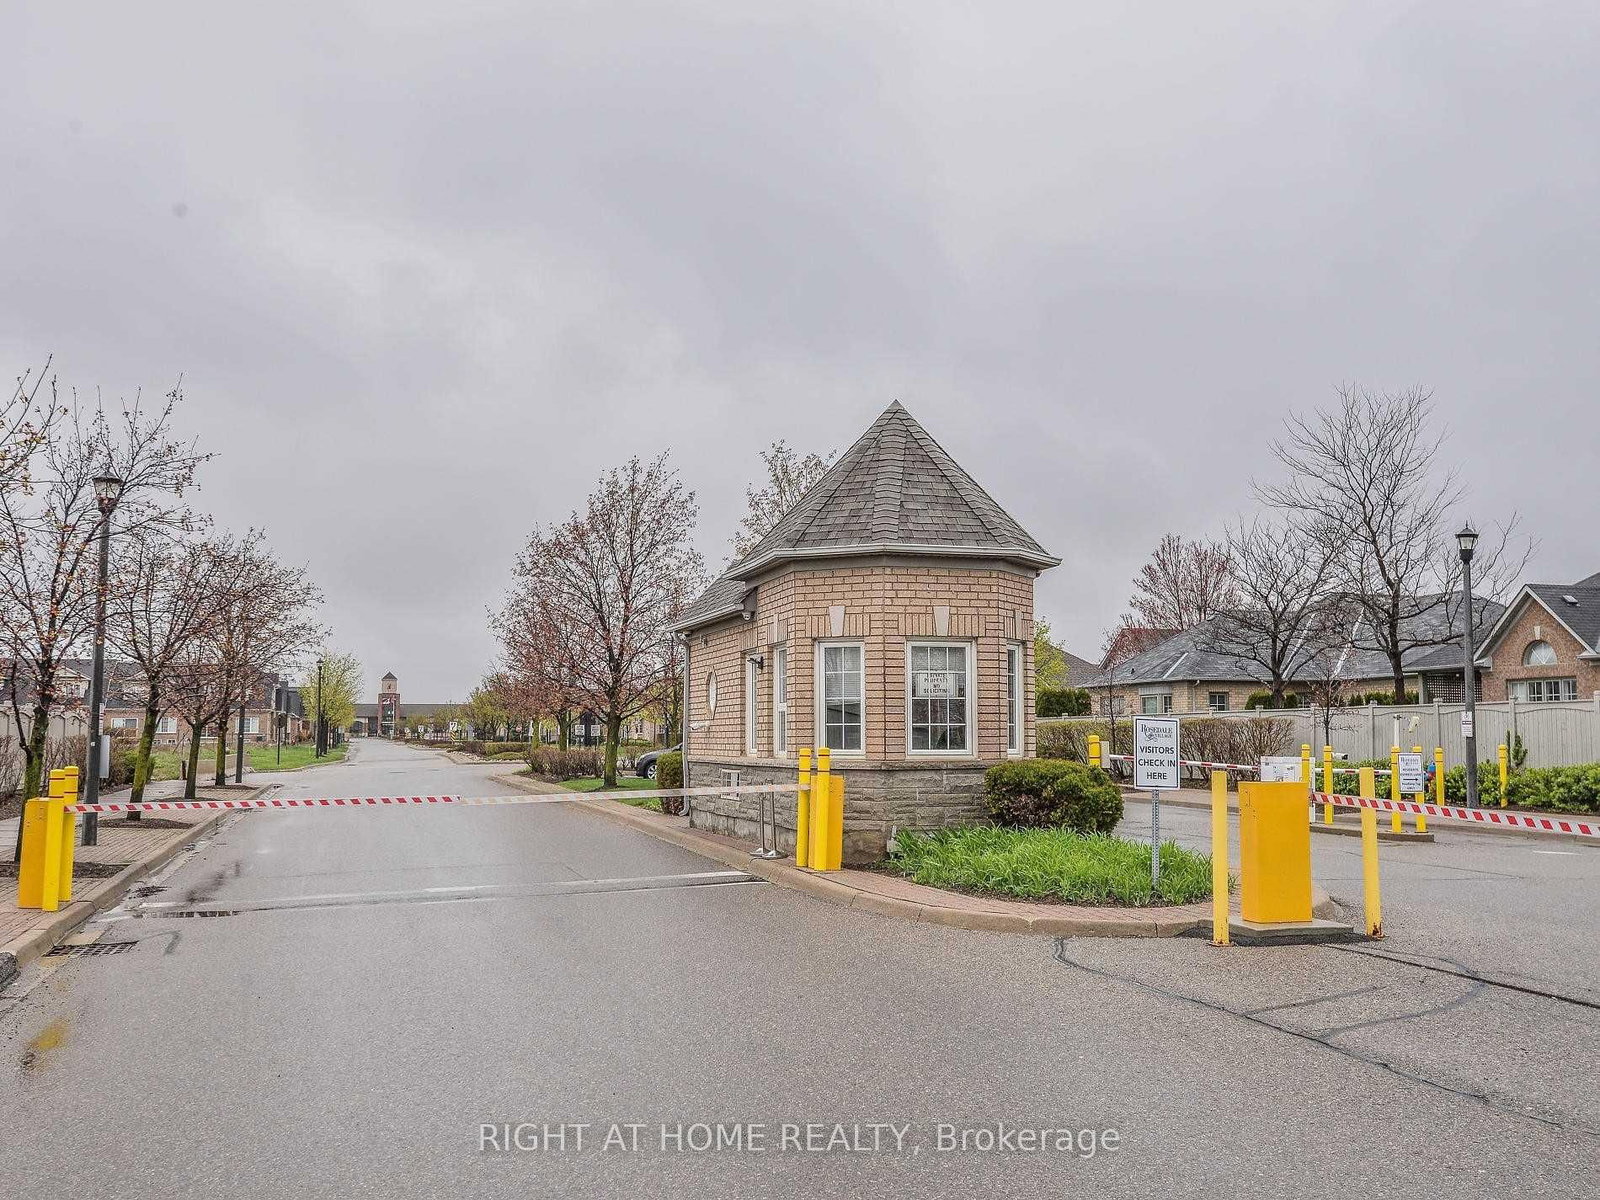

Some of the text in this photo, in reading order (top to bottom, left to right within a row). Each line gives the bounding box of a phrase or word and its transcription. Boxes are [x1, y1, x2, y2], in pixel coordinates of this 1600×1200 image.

[1141, 724, 1173, 734] ROSEDALE
[1140, 746, 1175, 755] VISITORS
[1138, 758, 1176, 768] CHECK IN
[1146, 772, 1168, 780] HERE
